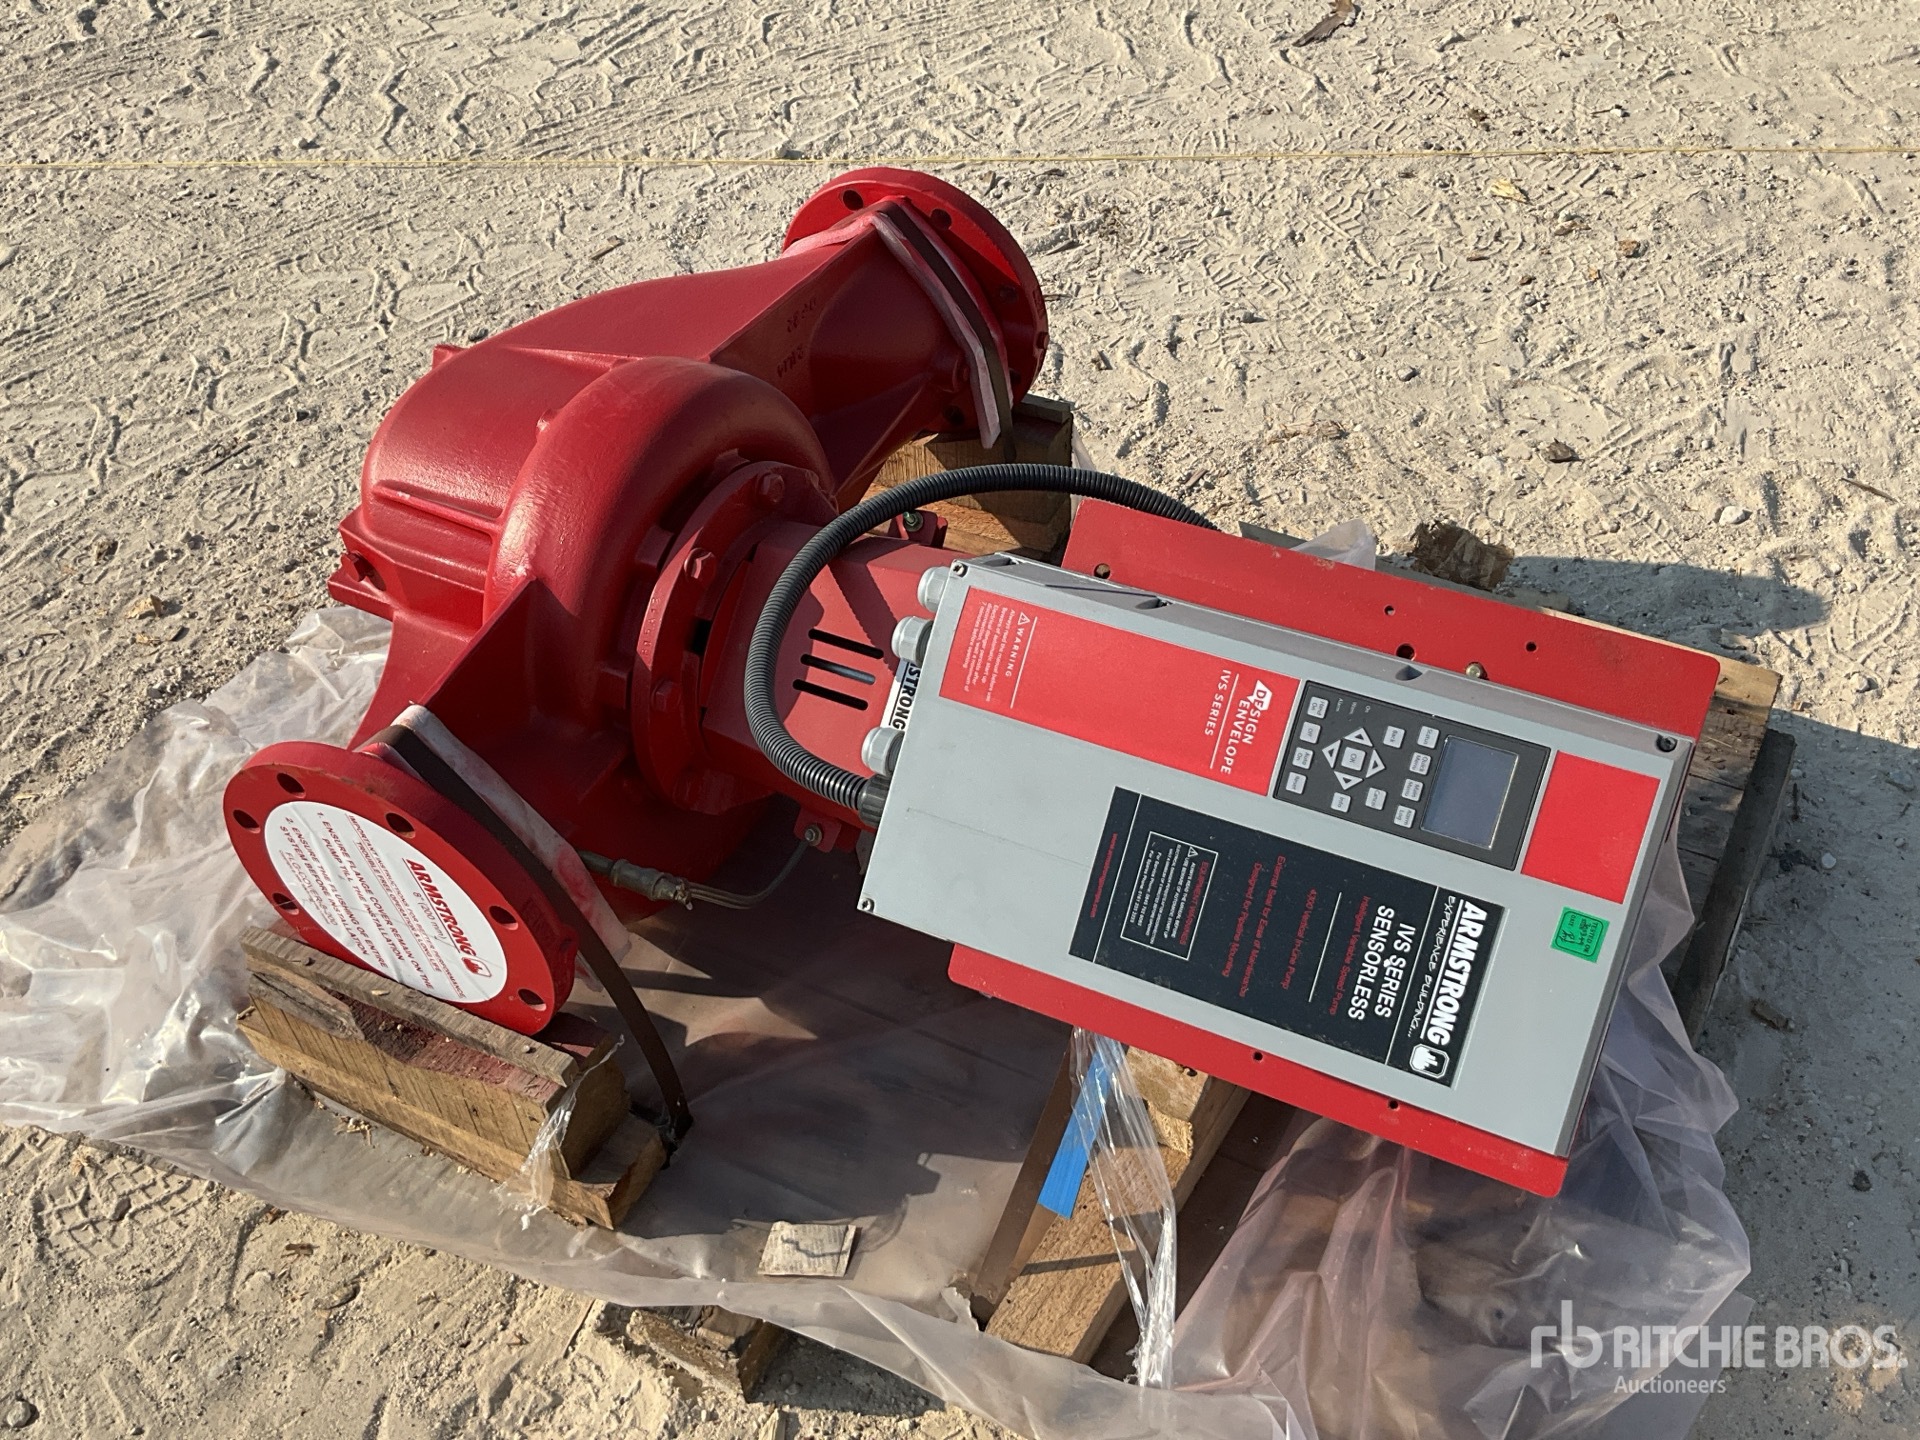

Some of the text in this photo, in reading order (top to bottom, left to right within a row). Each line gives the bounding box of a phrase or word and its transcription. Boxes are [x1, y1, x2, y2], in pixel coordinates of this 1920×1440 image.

[974, 605, 984, 627] minutes
[997, 606, 1007, 627] Beware
[1004, 609, 1015, 629] Always
[968, 627, 978, 645] before
[971, 603, 998, 685] Electrical danger persists after
[1001, 629, 1009, 643] read
[961, 646, 973, 668] opening
[987, 633, 999, 661] automatic
[1004, 626, 1024, 677] WARNING
[964, 658, 976, 684] minimum
[983, 662, 991, 675] start
[992, 652, 1003, 673] manual
[980, 674, 987, 683] up
[988, 673, 997, 691] before
[891, 662, 922, 731] STRONG
[1203, 668, 1231, 736] IVS SERIES
[1310, 701, 1317, 711] On
[1334, 697, 1343, 712] Alarm
[1241, 688, 1267, 744] DESIGN
[1219, 699, 1250, 774] ENVELOPE
[1389, 729, 1397, 742] Back
[1423, 728, 1432, 745] Status
[1295, 752, 1302, 761] On
[1348, 752, 1357, 763] OK
[1411, 754, 1421, 771] Menu
[1418, 755, 1428, 772] Quick
[1369, 789, 1381, 808] Cancel
[1403, 781, 1413, 797] Menu
[1411, 784, 1419, 798] Main
[1335, 796, 1345, 808] Info
[1171, 843, 1181, 867] ELECTRICAL
[1142, 858, 1151, 874] Spares
[1150, 860, 1159, 877] Service
[1166, 866, 1175, 883] DANGER
[1177, 866, 1186, 885] BEWARE
[1186, 862, 1196, 880] ALWAYS
[1269, 854, 1286, 888] External
[278, 824, 308, 862] SYSTEM
[303, 862, 331, 897] BEFORE
[325, 897, 369, 955] INSTALLATION
[1183, 879, 1191, 892] READ
[290, 826, 321, 864] ENSURE
[315, 865, 332, 882] THE
[326, 883, 360, 925] FLUSHING
[355, 926, 369, 938] OF
[363, 939, 389, 968] ENTIRE
[321, 837, 405, 961] PUMP TILL THE INSTALLATION
[321, 820, 351, 858] ENSURE
[345, 859, 374, 895] FLANGE
[368, 896, 394, 926] COVER
[388, 926, 415, 959] REMAIN
[410, 960, 424, 973] ON
[418, 973, 435, 990] THE
[347, 815, 466, 999] IMPORTANT INSTRUCTIONS FOR BETTER PERFORMANCE
[355, 841, 380, 873] TROUBLE
[376, 875, 393, 893] FREE
[387, 893, 417, 931] OPERATION
[415, 939, 432, 957] LONG
[427, 958, 442, 973] LIFE
[403, 857, 479, 956] ARMSTRONG
[1168, 891, 1179, 917] AUTOMATIC
[1178, 860, 1209, 945] EQUIPMENT WARNINGS
[1264, 888, 1276, 906] Seal
[416, 902, 436, 921] (200
[428, 921, 447, 940] mm)
[1175, 901, 1185, 920] MANUAL
[1221, 861, 1262, 977] Designed for Pipeline Mounting
[1164, 916, 1172, 931] START
[1170, 919, 1180, 938] BEFORE
[1254, 918, 1267, 939] Ease
[1296, 909, 1312, 939] Vertical
[1425, 894, 1456, 972] EXPERIENCE
[1251, 938, 1261, 949] of
[1288, 938, 1303, 965] In-Line
[1327, 894, 1371, 1016] Intelligent Variable Speed Pump
[1346, 904, 1395, 1021] SENSORLESS
[1237, 948, 1259, 998] Maintenance
[1278, 965, 1295, 990] Pump
[1373, 922, 1416, 1018] IVS SERIES
[1424, 900, 1489, 1047] ARMSTRONG
